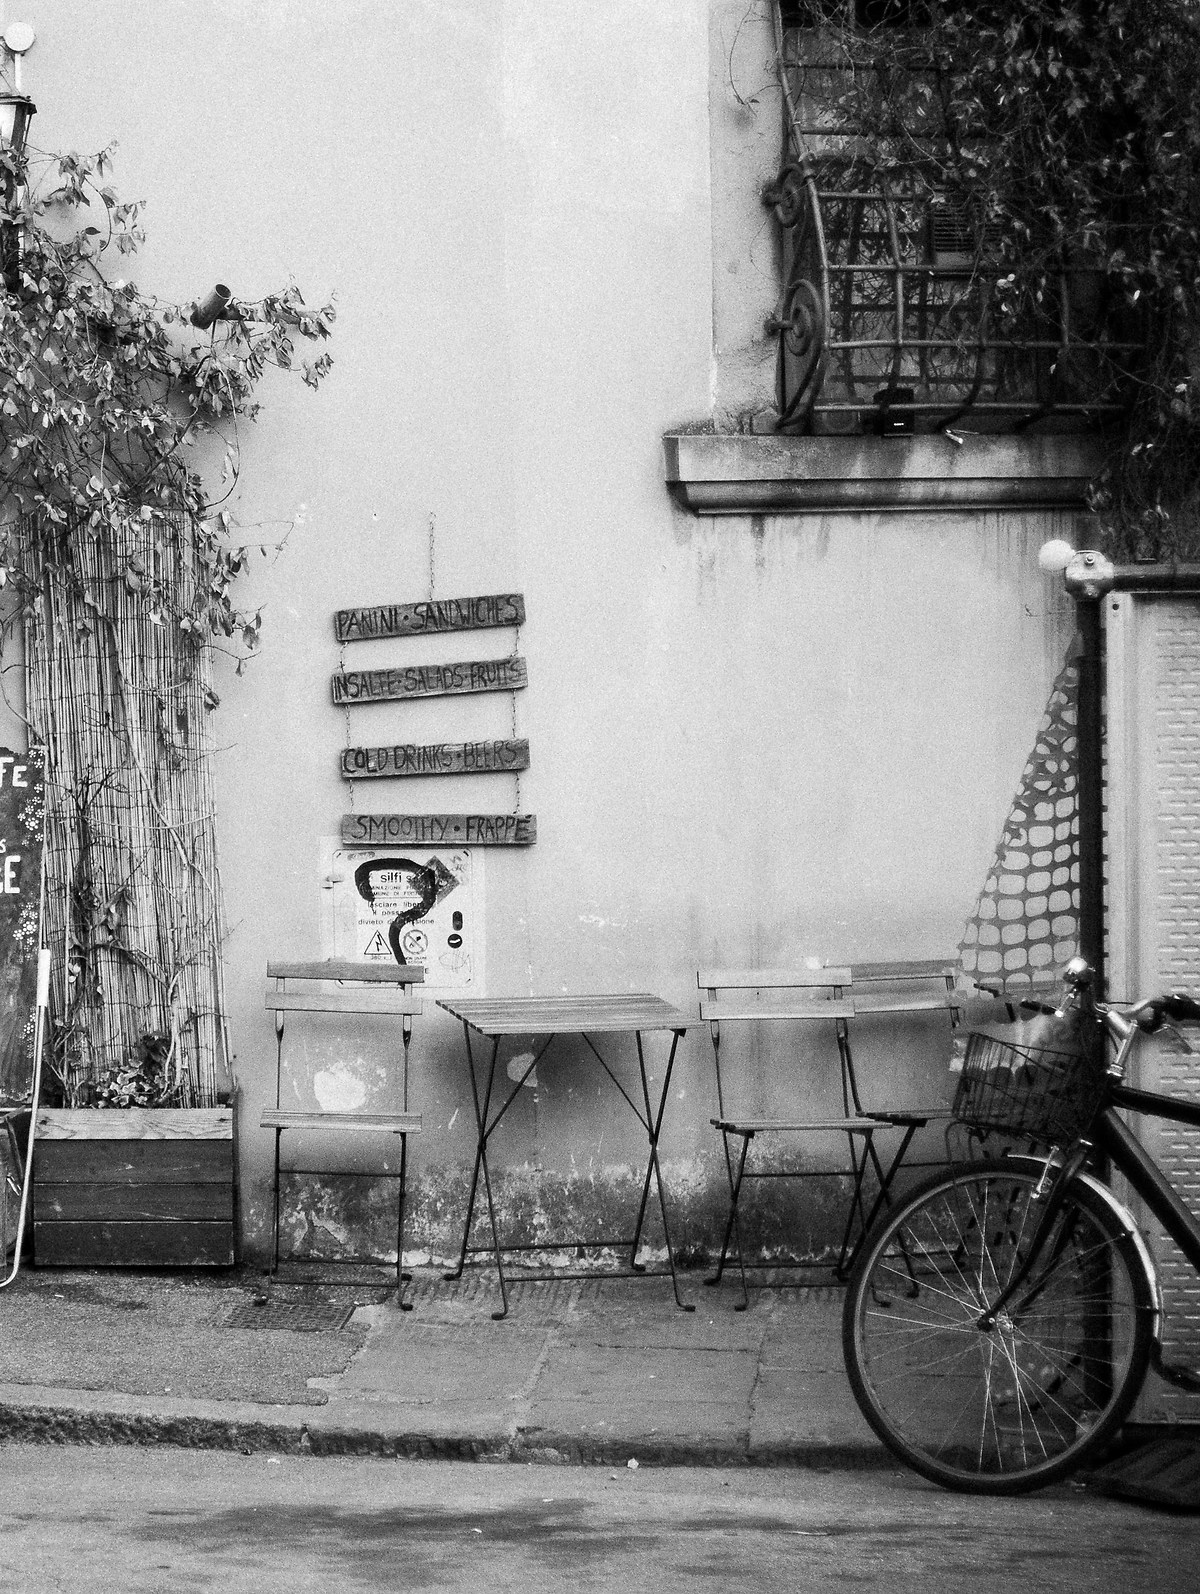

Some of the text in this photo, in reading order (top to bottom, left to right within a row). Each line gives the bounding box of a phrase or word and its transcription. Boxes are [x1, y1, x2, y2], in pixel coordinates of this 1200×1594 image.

[337, 595, 518, 638] PANINI SANDWICHES
[405, 666, 464, 691] SALADS
[343, 747, 389, 774] COLD
[464, 740, 517, 768] BEERS
[352, 816, 449, 841] SMOOTHY
[380, 872, 402, 883] silfi
